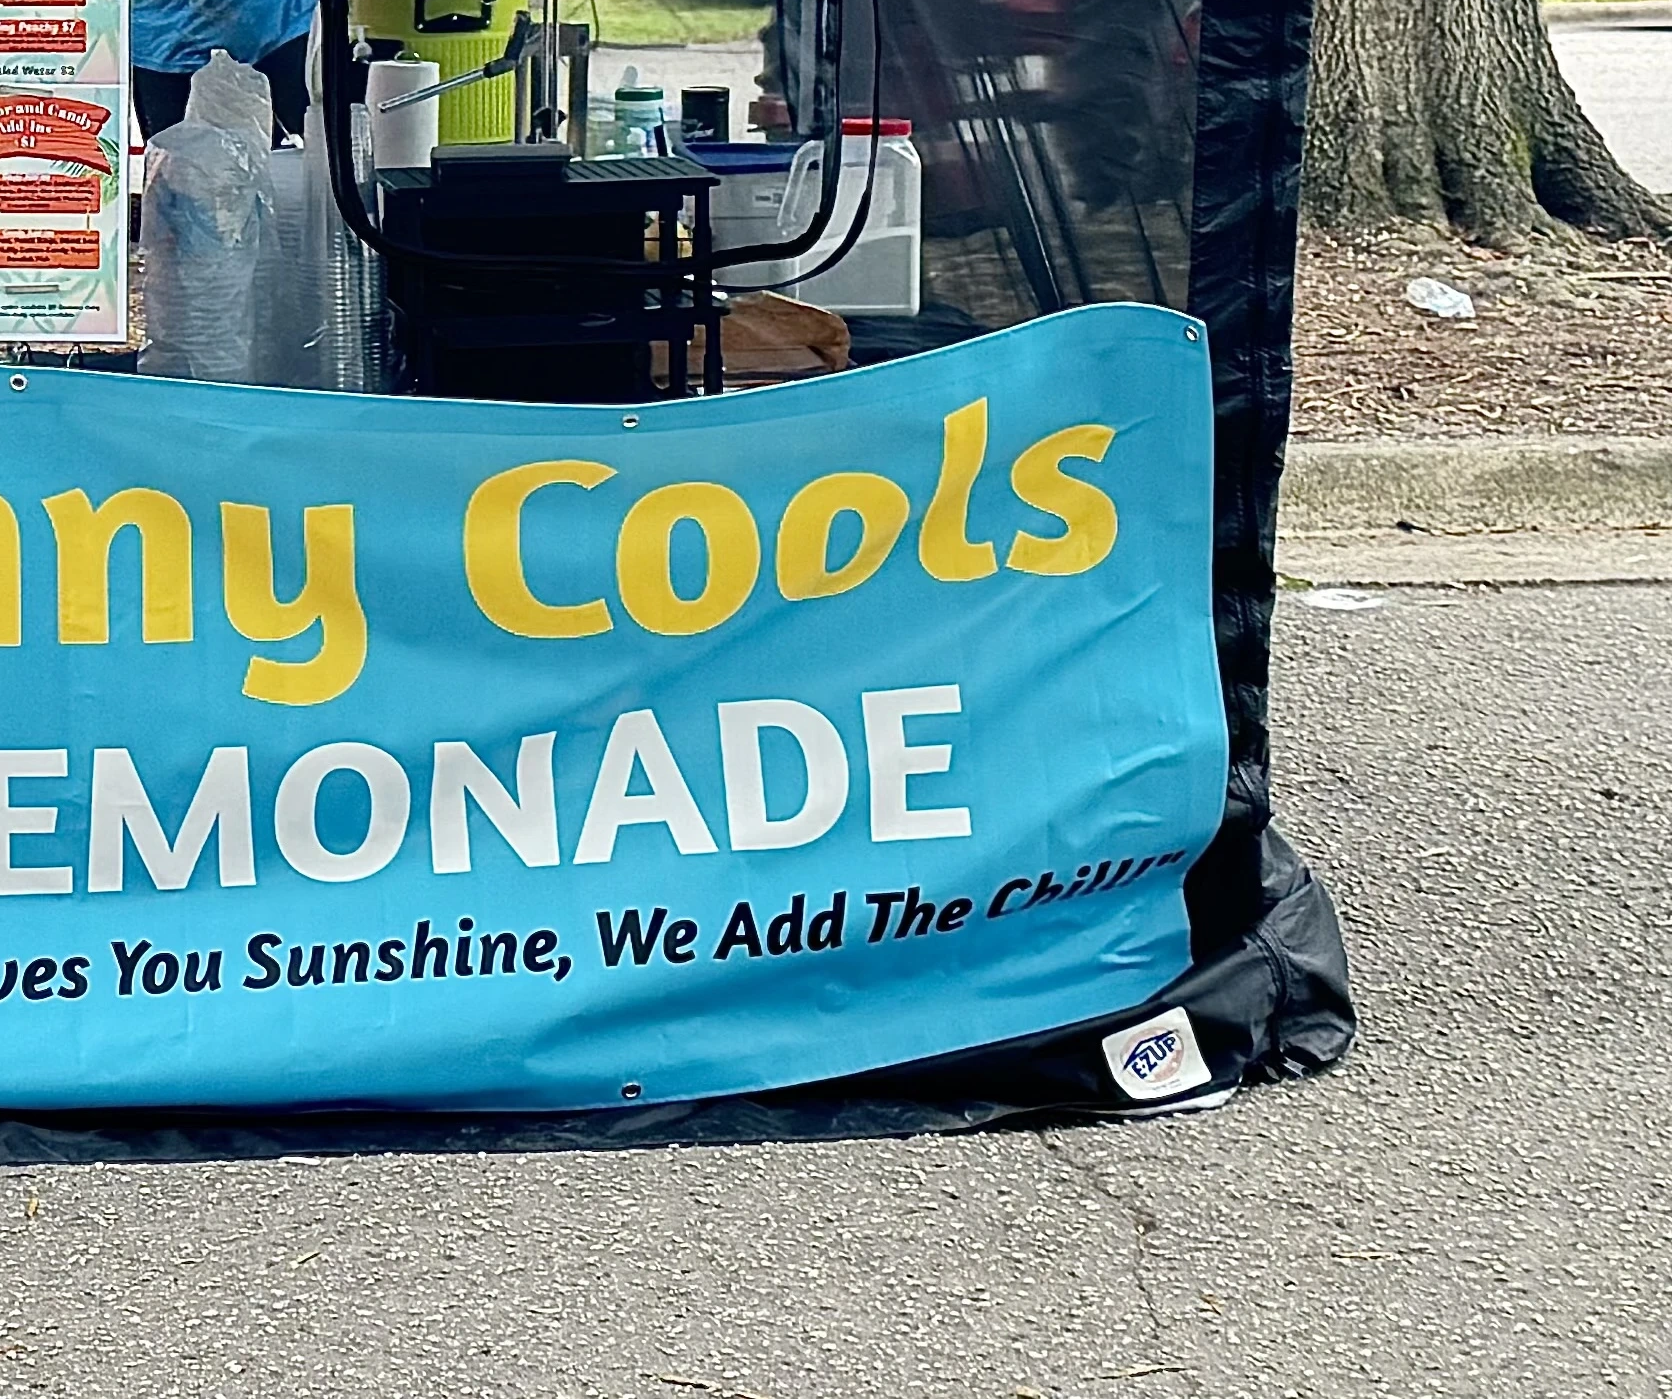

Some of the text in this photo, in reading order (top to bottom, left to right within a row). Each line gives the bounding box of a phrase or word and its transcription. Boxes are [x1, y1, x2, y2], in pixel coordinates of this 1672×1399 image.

[15, 101, 45, 115] and
[47, 104, 92, 131] Candy
[464, 397, 1118, 638] Cools
[112, 939, 223, 996] You
[242, 917, 572, 992] Sunshine,
[597, 907, 698, 967] We
[714, 891, 848, 960] Add
[865, 885, 973, 944] The
